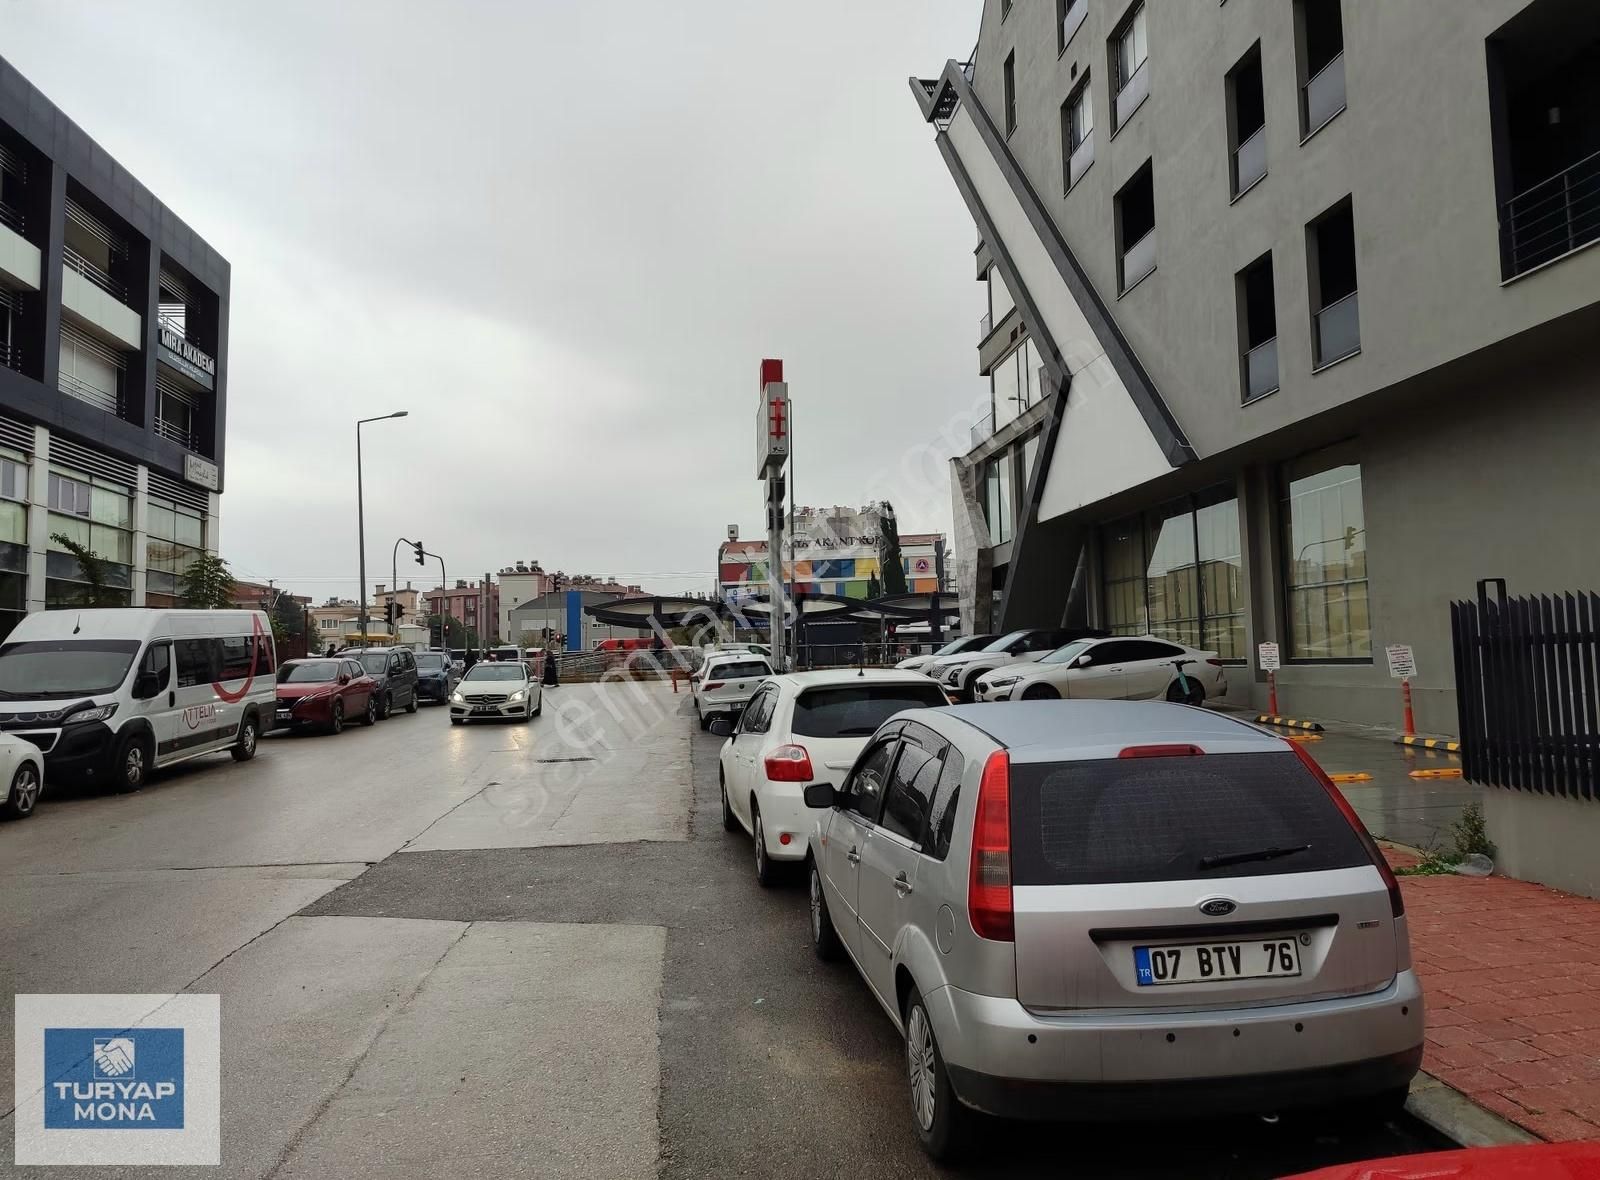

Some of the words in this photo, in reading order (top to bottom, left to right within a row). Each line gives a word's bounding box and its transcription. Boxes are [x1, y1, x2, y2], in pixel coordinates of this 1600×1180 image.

[1209, 903, 1229, 912] Ford
[1152, 949, 1181, 980] 07
[1197, 945, 1241, 977] BTV
[1263, 942, 1293, 973] 76
[1139, 968, 1151, 977] TR
